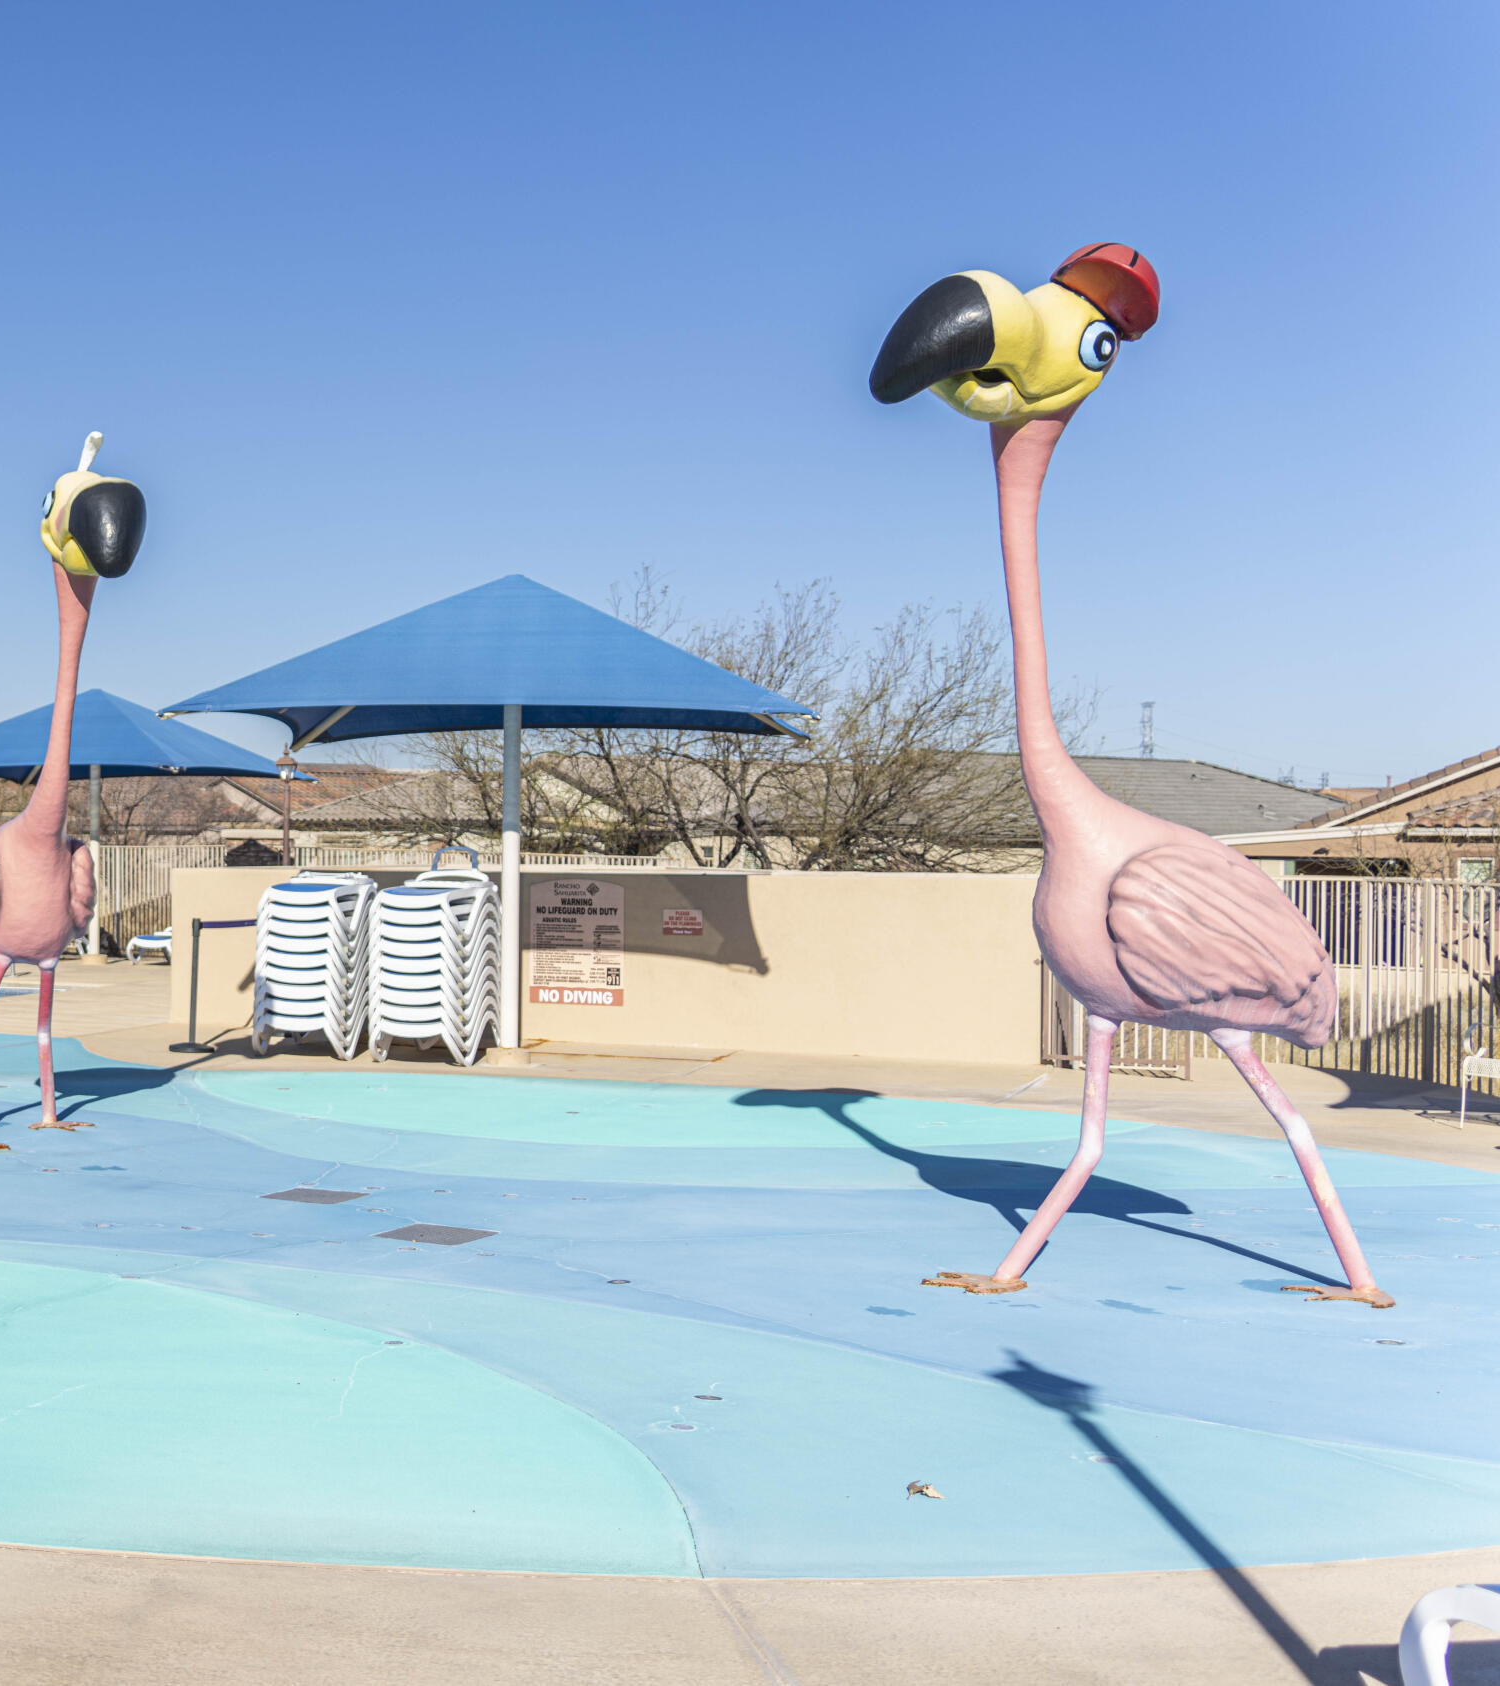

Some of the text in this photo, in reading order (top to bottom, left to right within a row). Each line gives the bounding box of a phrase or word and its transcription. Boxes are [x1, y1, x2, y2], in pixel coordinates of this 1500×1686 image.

[561, 898, 593, 906] WARNING
[536, 906, 618, 916] NO LIFEGUARD ON DUTY
[607, 975, 620, 985] 911
[539, 989, 614, 1005] NO DIVING
